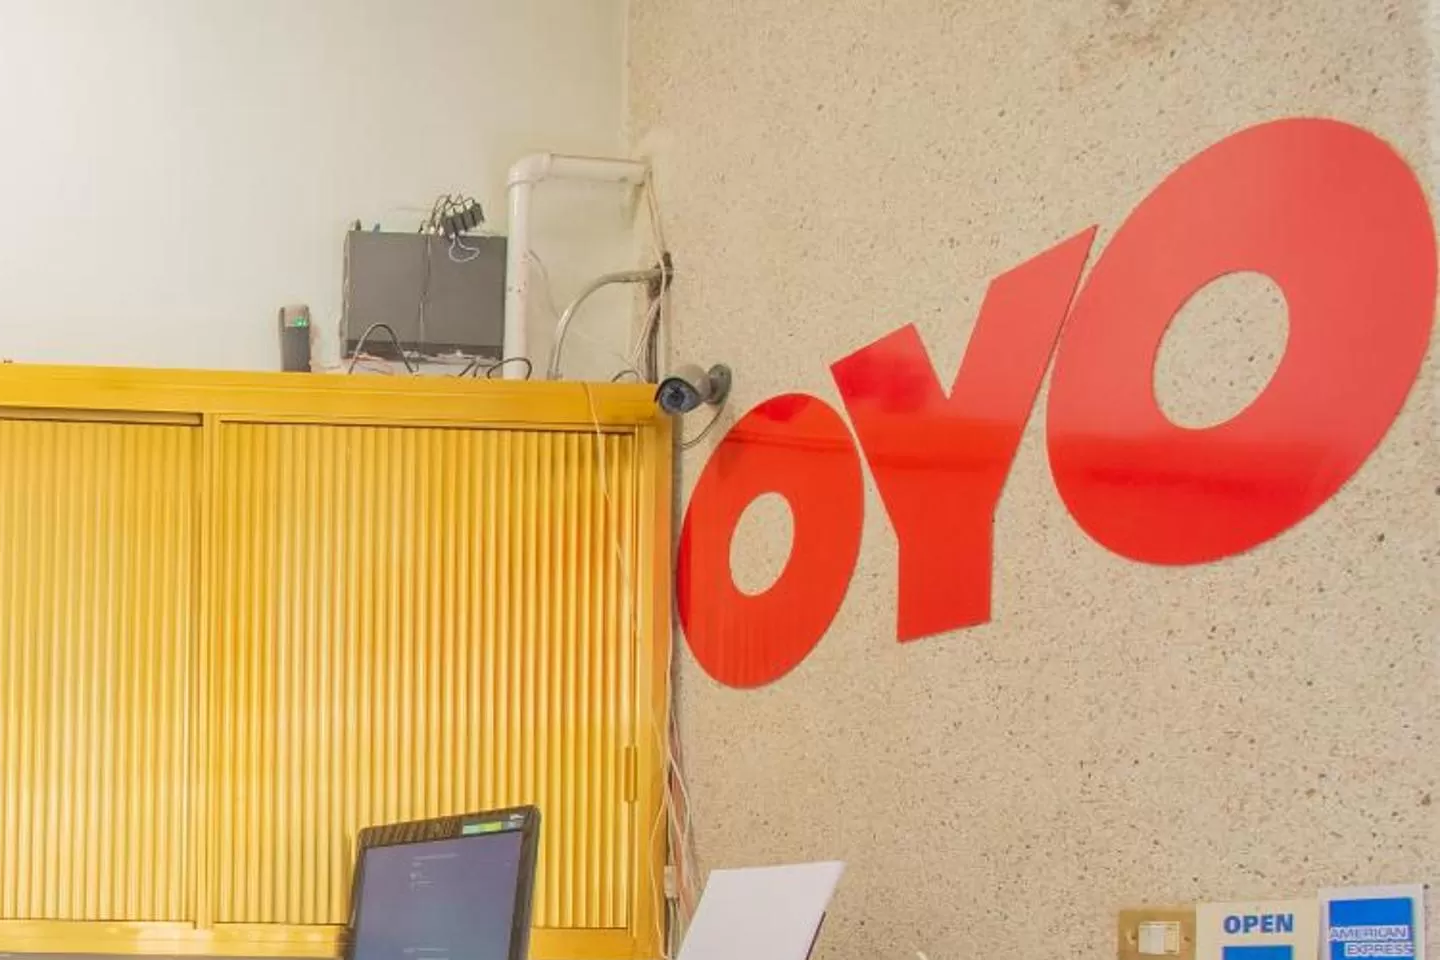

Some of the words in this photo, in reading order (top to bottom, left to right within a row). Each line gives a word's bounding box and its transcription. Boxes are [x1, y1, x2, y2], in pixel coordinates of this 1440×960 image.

[676, 117, 1438, 689] OYO
[1223, 913, 1294, 934] OPEN
[1329, 926, 1407, 940] AMERICAN
[1347, 943, 1416, 955] EXPRESS
